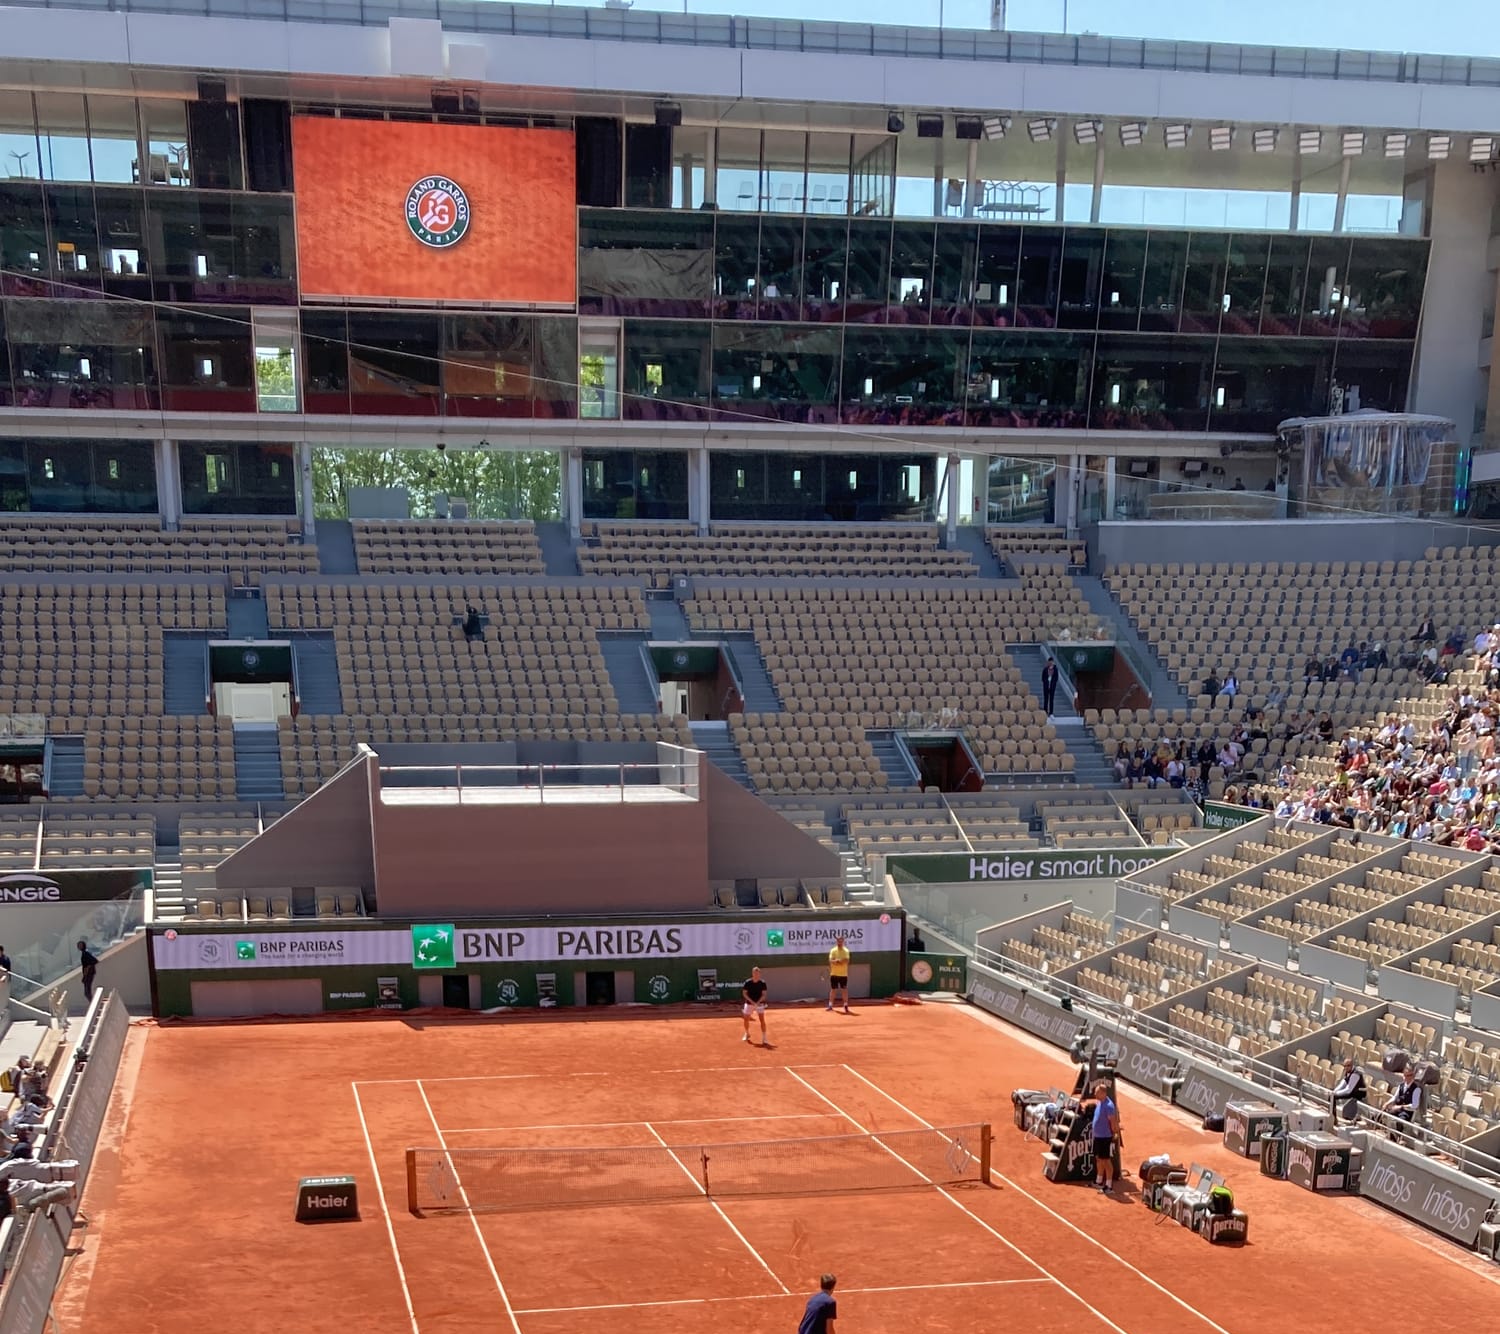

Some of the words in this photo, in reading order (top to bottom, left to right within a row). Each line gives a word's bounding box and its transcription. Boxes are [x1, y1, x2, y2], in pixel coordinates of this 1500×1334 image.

[408, 180, 435, 218] ROLAND
[438, 180, 467, 221] GARROS
[418, 228, 458, 243] PARIS
[969, 855, 1034, 879] Haier
[1039, 854, 1104, 877] smart
[1109, 854, 1162, 875] hom
[462, 932, 526, 958] BNP
[557, 928, 683, 956] PARIBAS
[788, 929, 812, 941] BNP
[815, 928, 864, 940] PARIBAS
[260, 941, 287, 953] BNP
[290, 940, 344, 953] PARIBAS
[939, 965, 961, 973] ROLEX
[1185, 1075, 1220, 1111] Infosys
[307, 1194, 349, 1209] Haier
[1367, 1159, 1416, 1203] Infosys
[1422, 1184, 1476, 1231] Infosys
